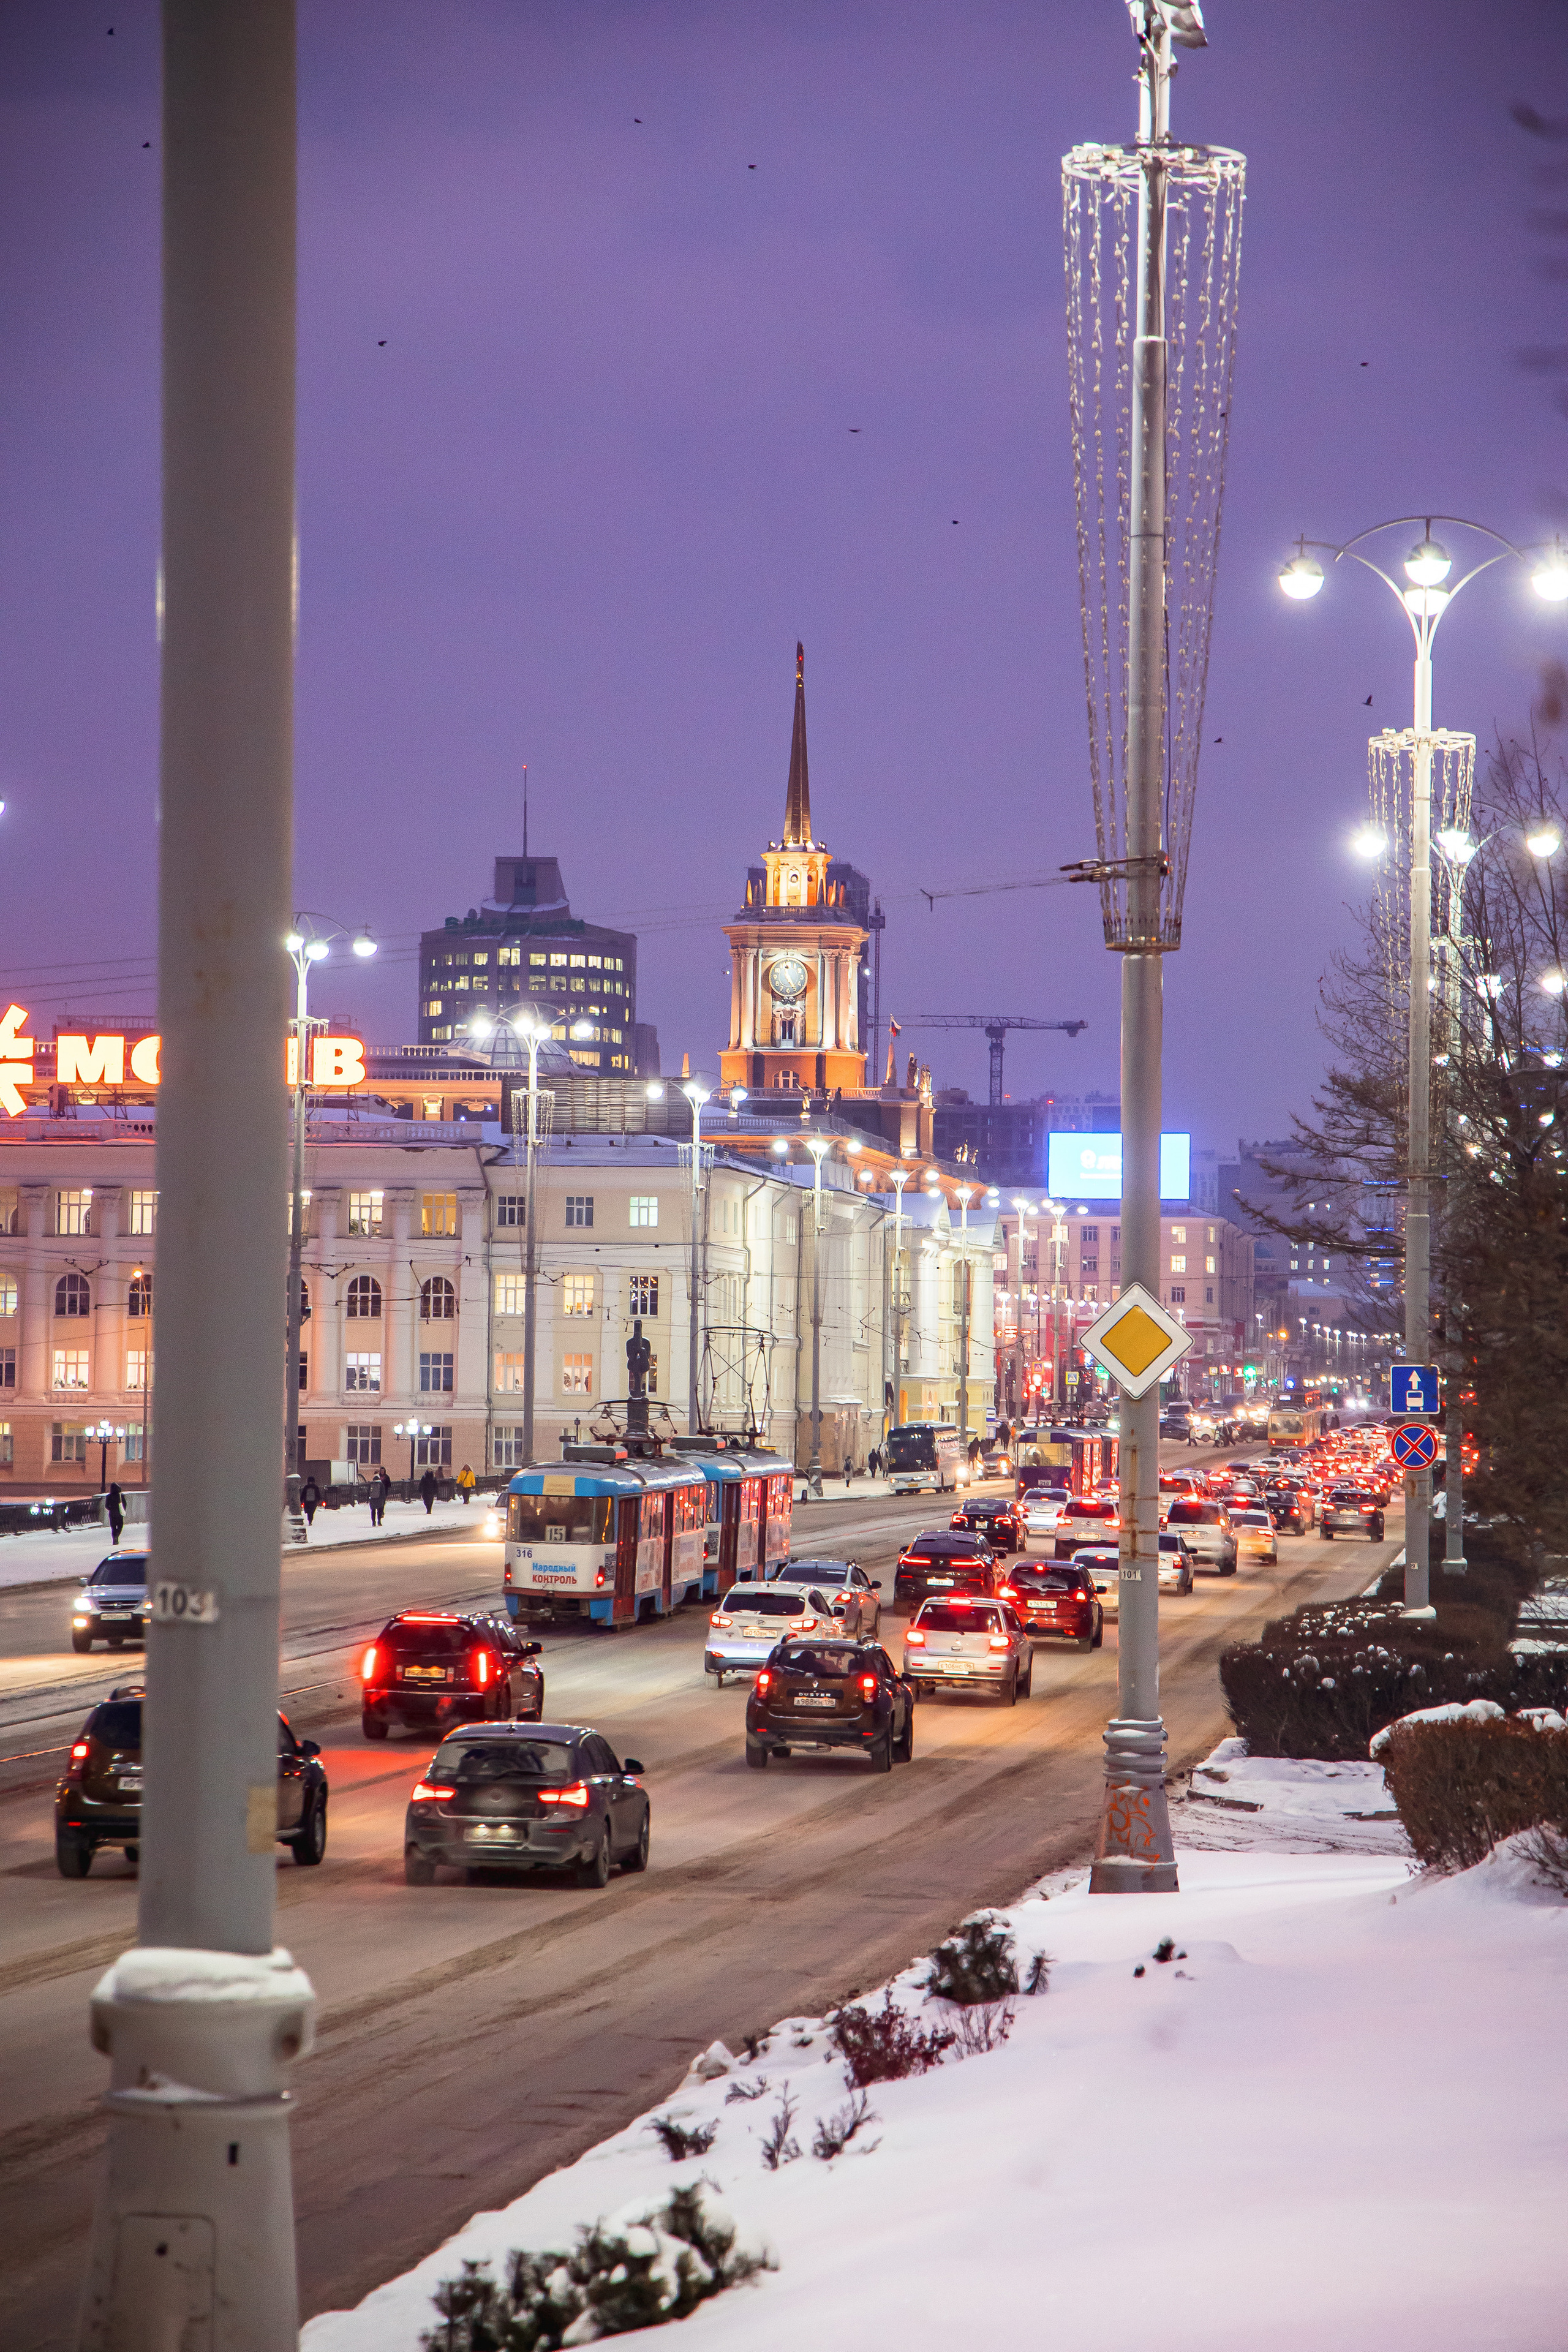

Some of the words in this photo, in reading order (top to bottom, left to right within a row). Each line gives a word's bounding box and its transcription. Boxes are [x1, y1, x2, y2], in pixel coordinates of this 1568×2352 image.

[549, 1528, 563, 1541] 15
[516, 1549, 532, 1558] 316
[532, 1562, 576, 1573] Народный
[1123, 1570, 1137, 1578] 101
[532, 1575, 577, 1585] КОНТРОЛЬ
[159, 1587, 205, 1615] 103
